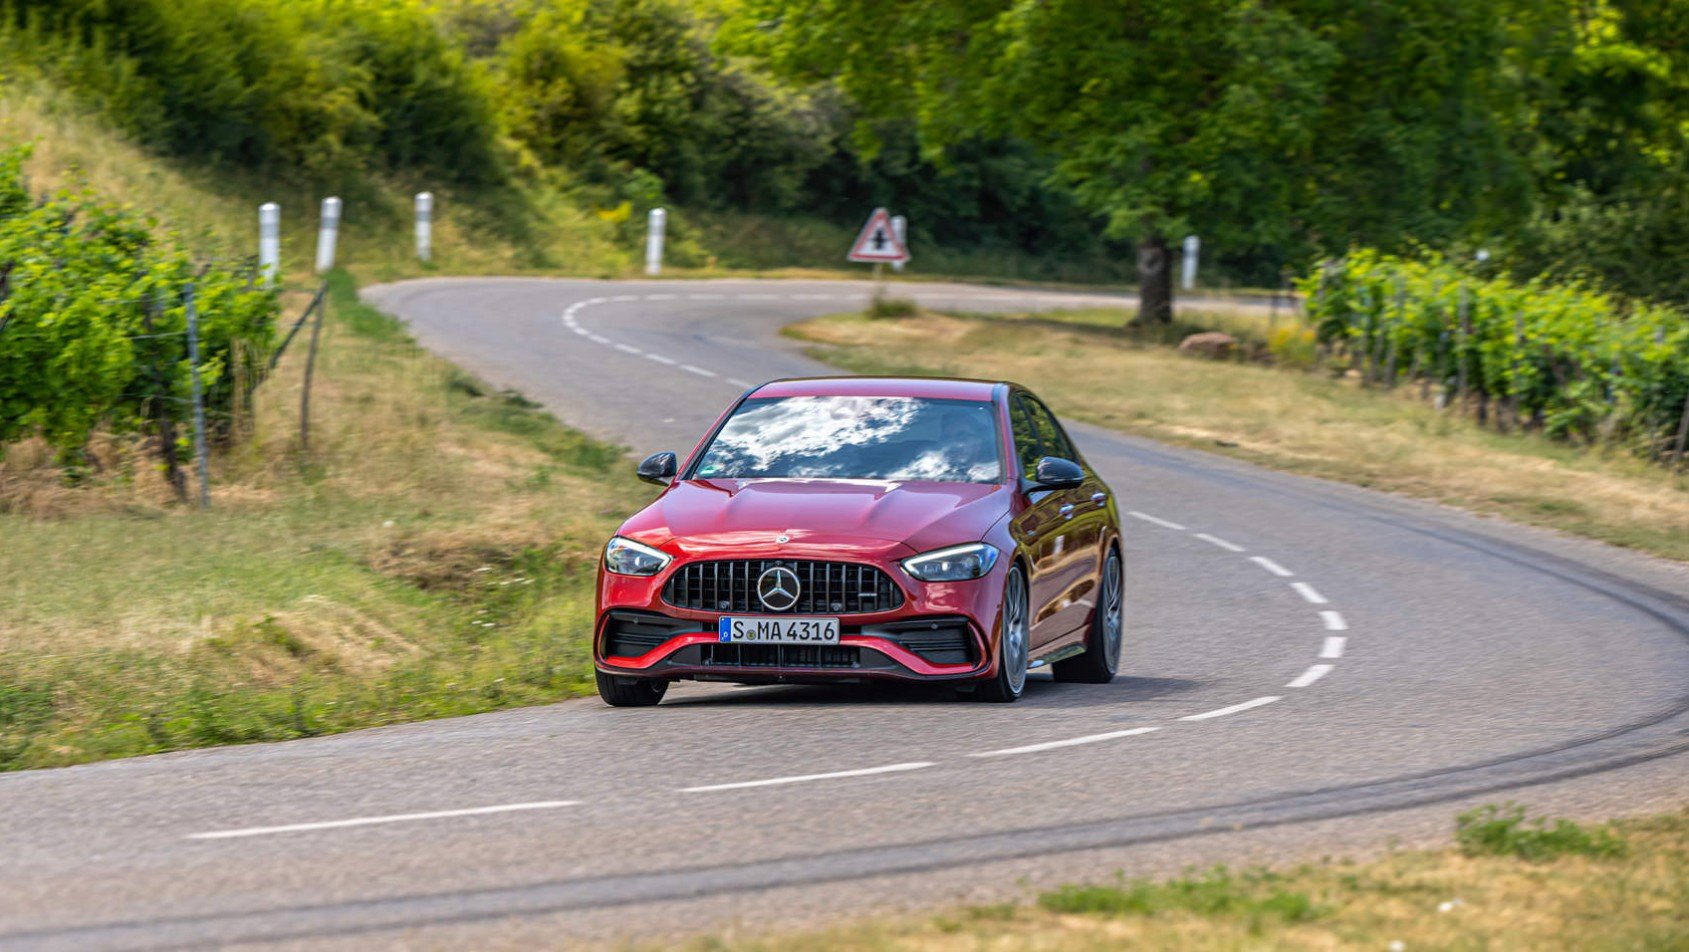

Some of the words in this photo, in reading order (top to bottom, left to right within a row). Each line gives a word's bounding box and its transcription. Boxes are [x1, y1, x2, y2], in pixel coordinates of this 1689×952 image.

[733, 621, 744, 639] S
[757, 622, 782, 640] MA
[787, 622, 835, 640] 4316
